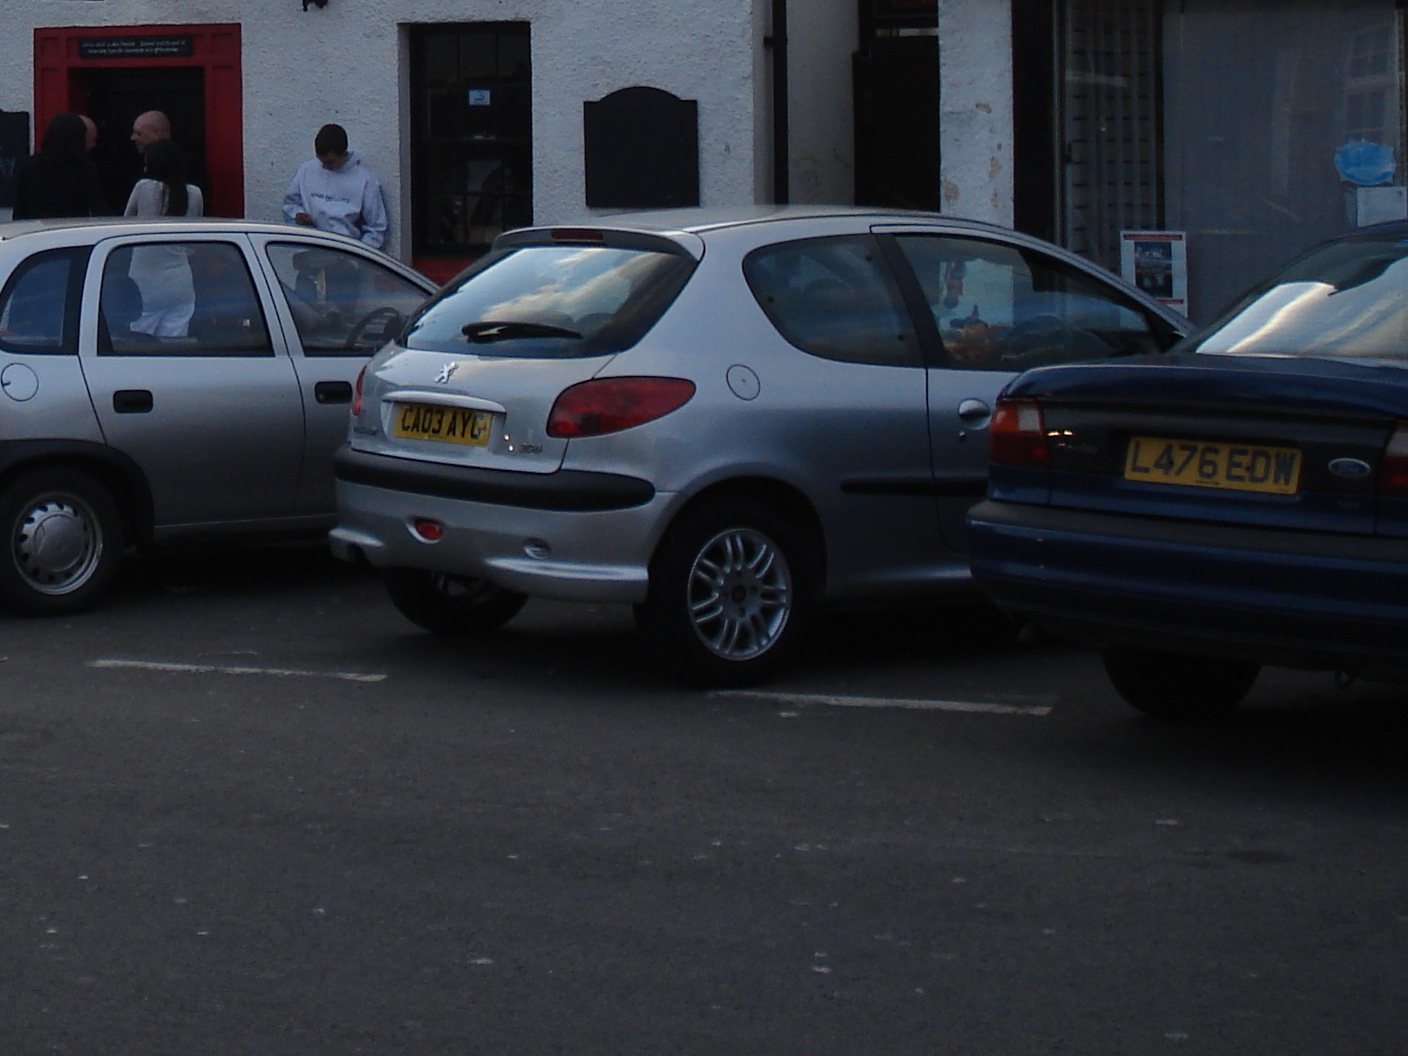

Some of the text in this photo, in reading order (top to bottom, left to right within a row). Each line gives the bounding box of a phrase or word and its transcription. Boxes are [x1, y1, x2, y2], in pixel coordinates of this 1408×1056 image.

[401, 405, 445, 435] CA03
[1130, 439, 1298, 486] L476 EDW
